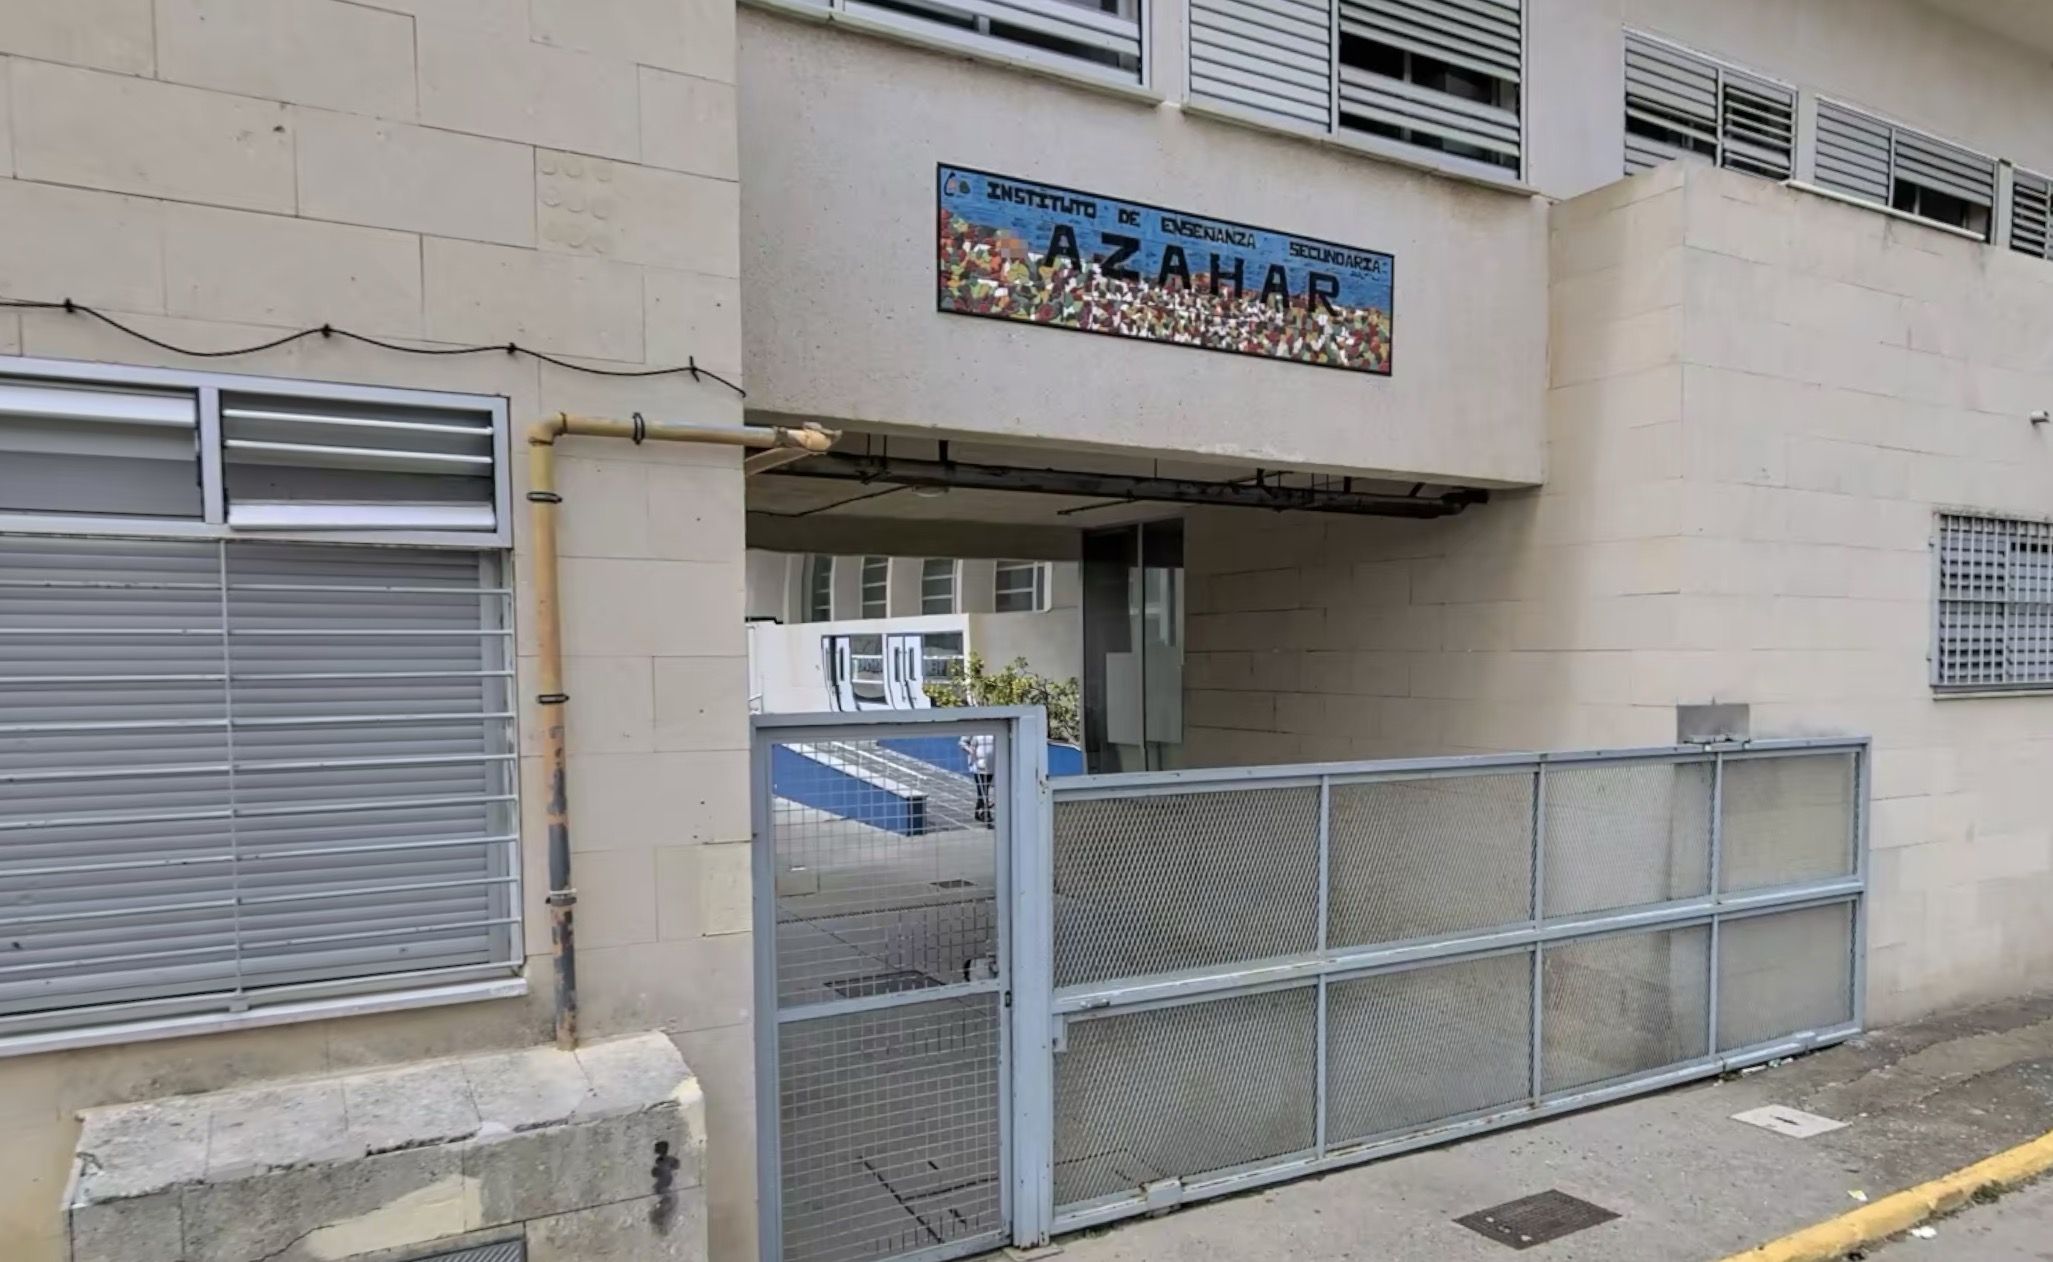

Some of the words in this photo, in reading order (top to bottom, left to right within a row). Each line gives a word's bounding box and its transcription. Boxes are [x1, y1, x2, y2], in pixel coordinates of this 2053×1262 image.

[987, 181, 1097, 219] INSTITUTO
[1118, 208, 1141, 227] DE
[1289, 241, 1381, 273] SECUNDARIA
[1044, 224, 1340, 317] AZAHAR
